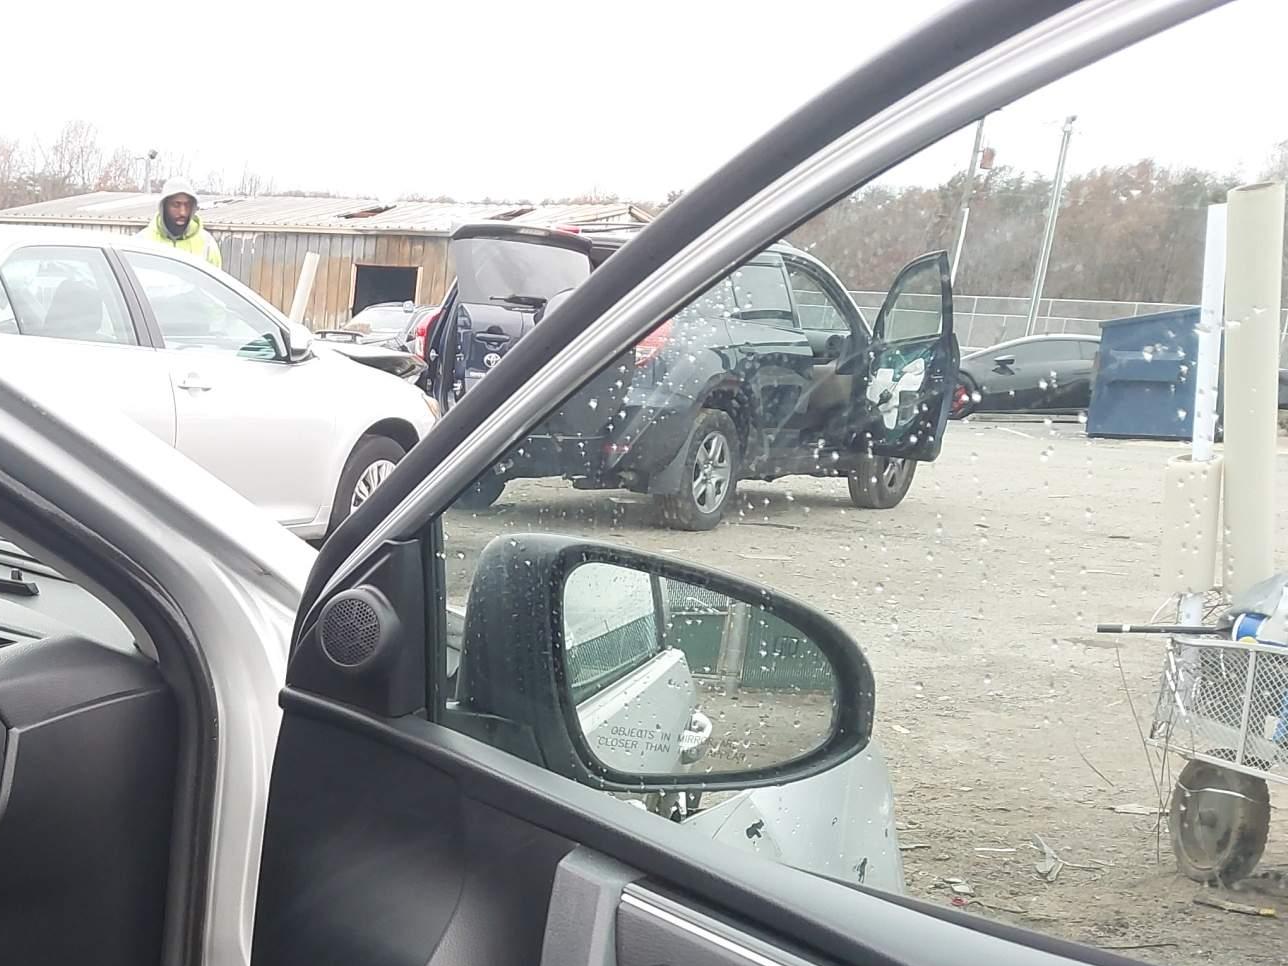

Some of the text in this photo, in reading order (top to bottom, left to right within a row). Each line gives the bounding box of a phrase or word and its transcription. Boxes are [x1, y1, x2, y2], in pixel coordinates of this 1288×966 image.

[611, 726, 655, 740] OBJECTS
[661, 732, 672, 742] IN
[598, 735, 638, 750] CLOSER
[645, 741, 671, 753] THAN
